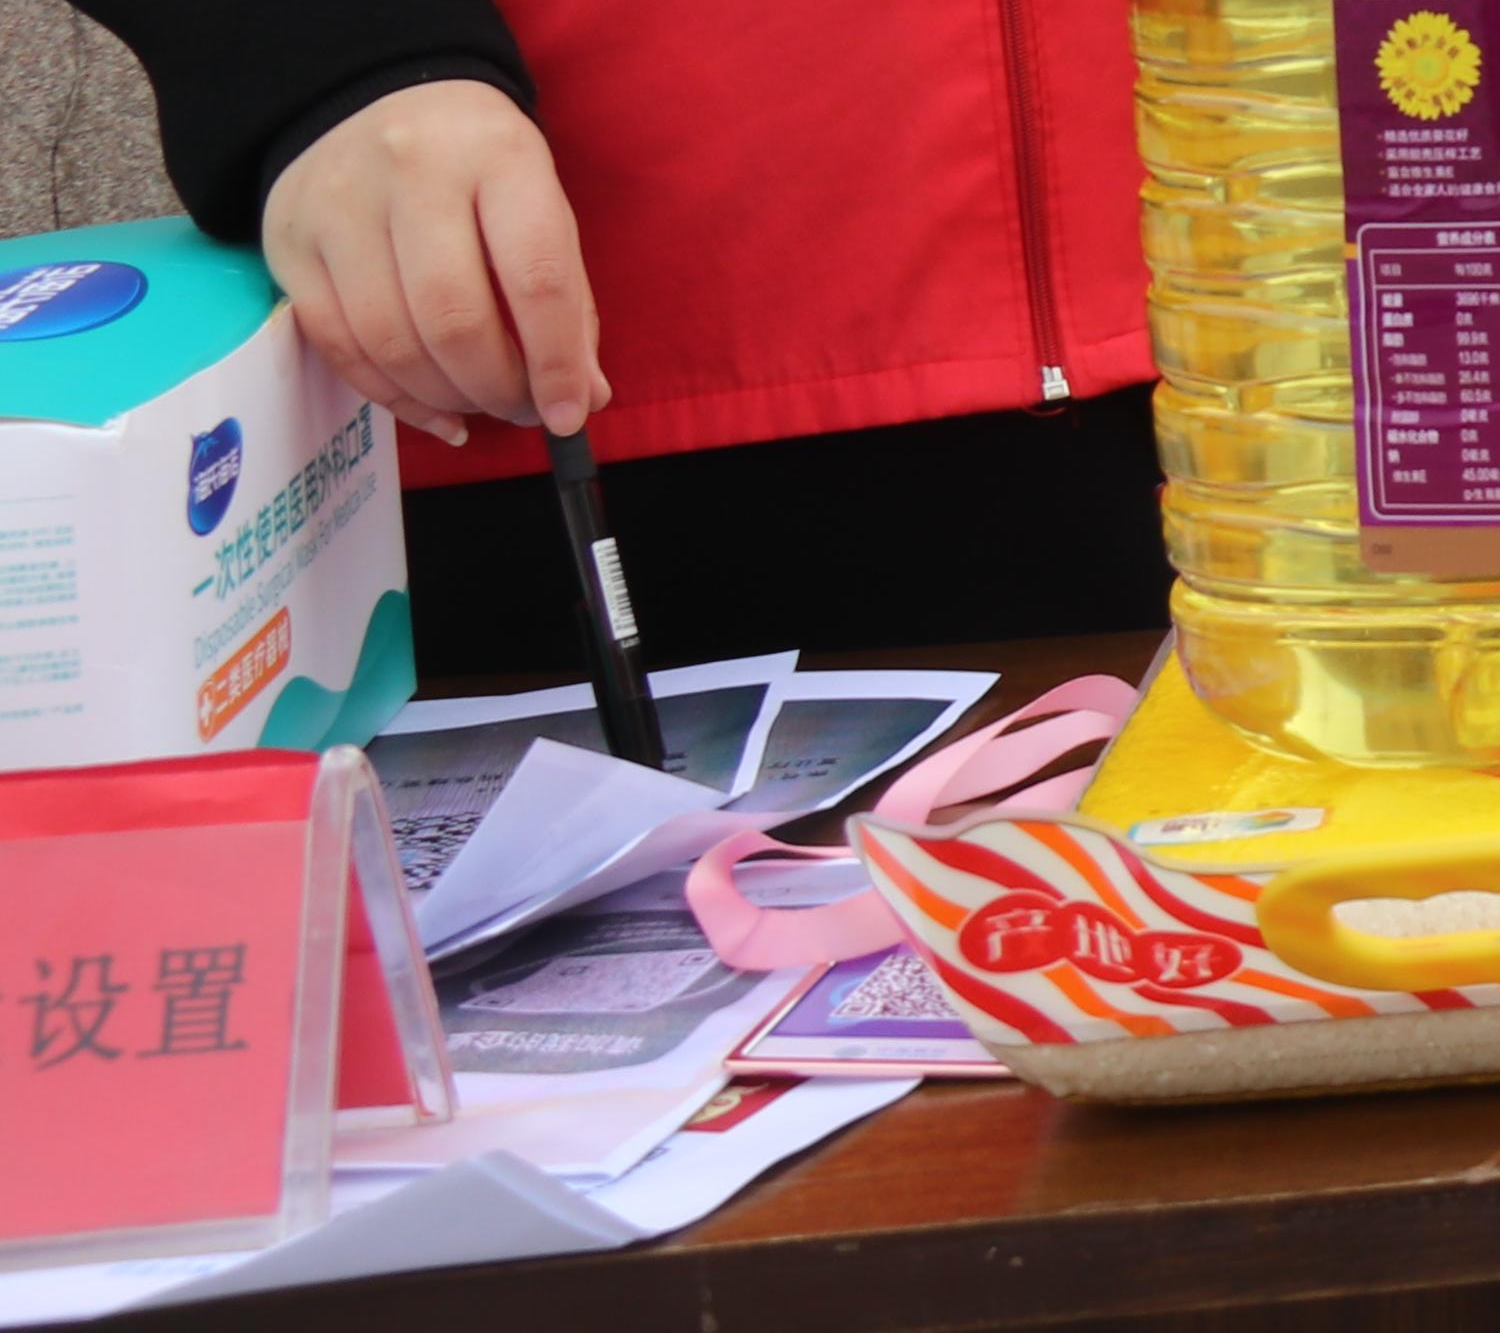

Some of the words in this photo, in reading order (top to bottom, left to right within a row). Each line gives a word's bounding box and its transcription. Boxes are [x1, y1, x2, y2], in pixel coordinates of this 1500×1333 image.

[985, 907, 1221, 982] 产地好
[17, 940, 249, 1073] 设置
